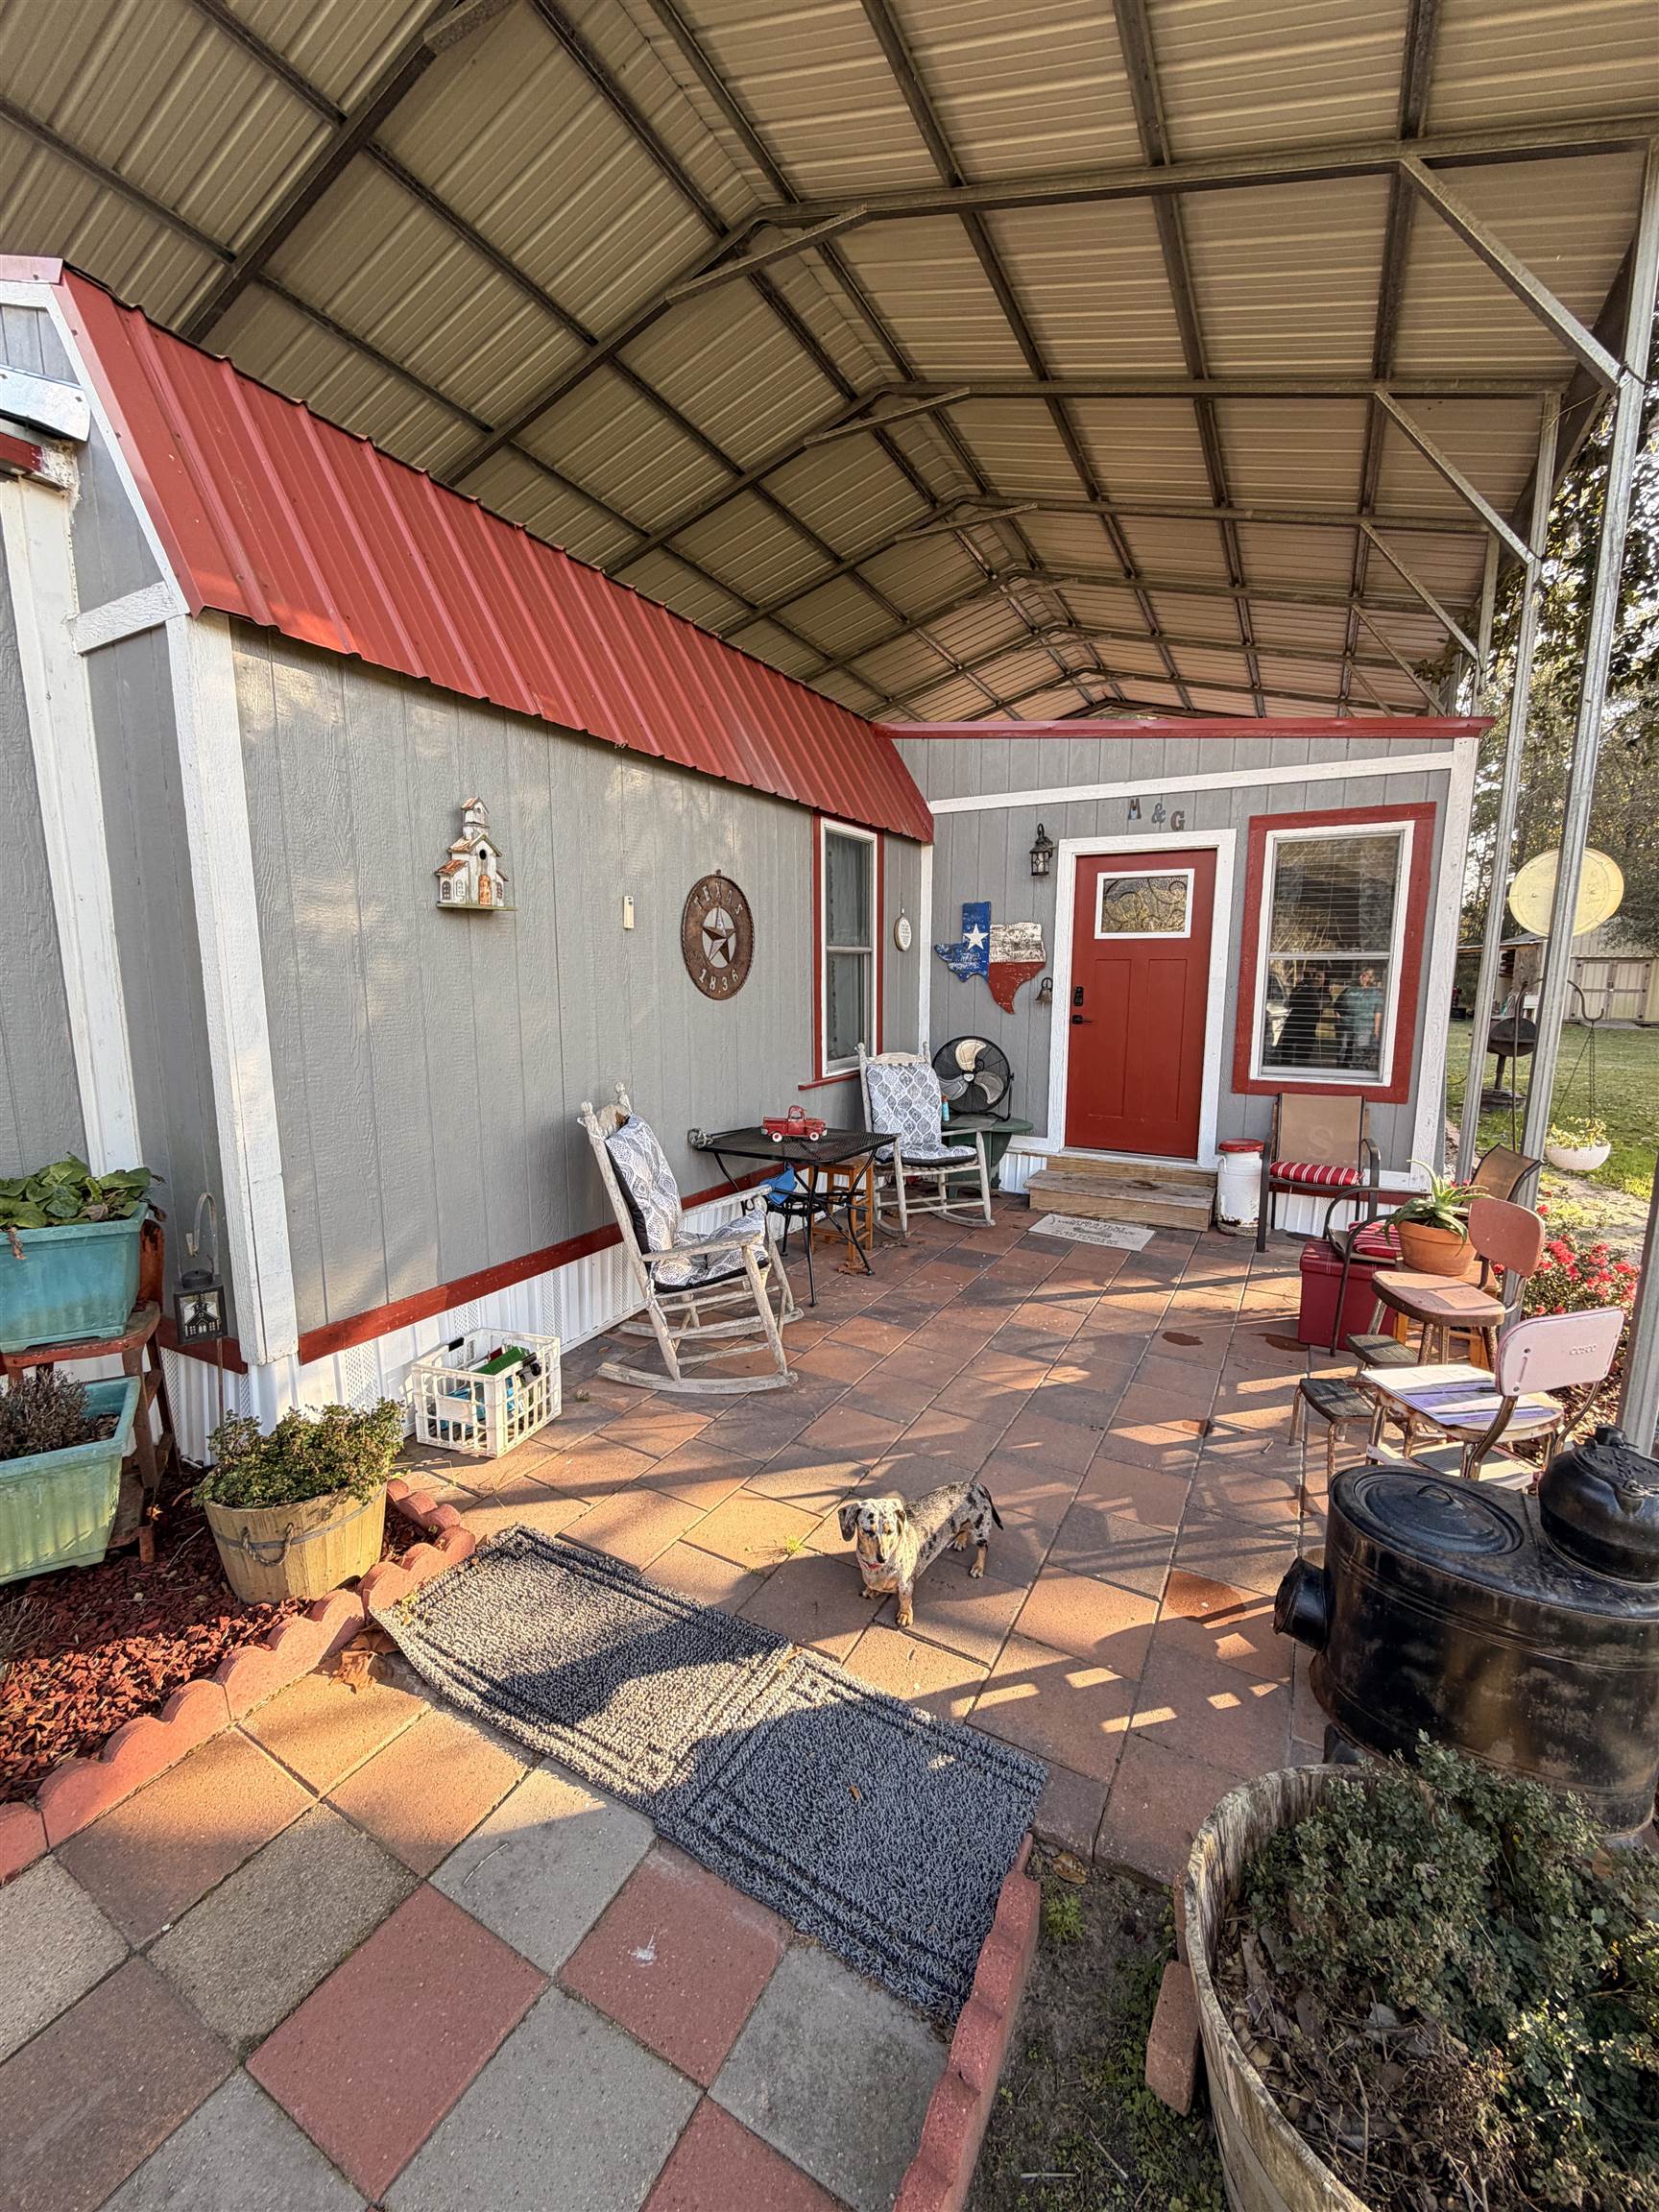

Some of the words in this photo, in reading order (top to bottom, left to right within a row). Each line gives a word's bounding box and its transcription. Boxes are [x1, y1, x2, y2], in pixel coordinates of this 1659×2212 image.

[1128, 798, 1142, 820] M
[1151, 803, 1166, 824] &
[1170, 810, 1186, 831] G
[693, 882, 743, 915] TEXAS
[698, 968, 738, 991] 1836
